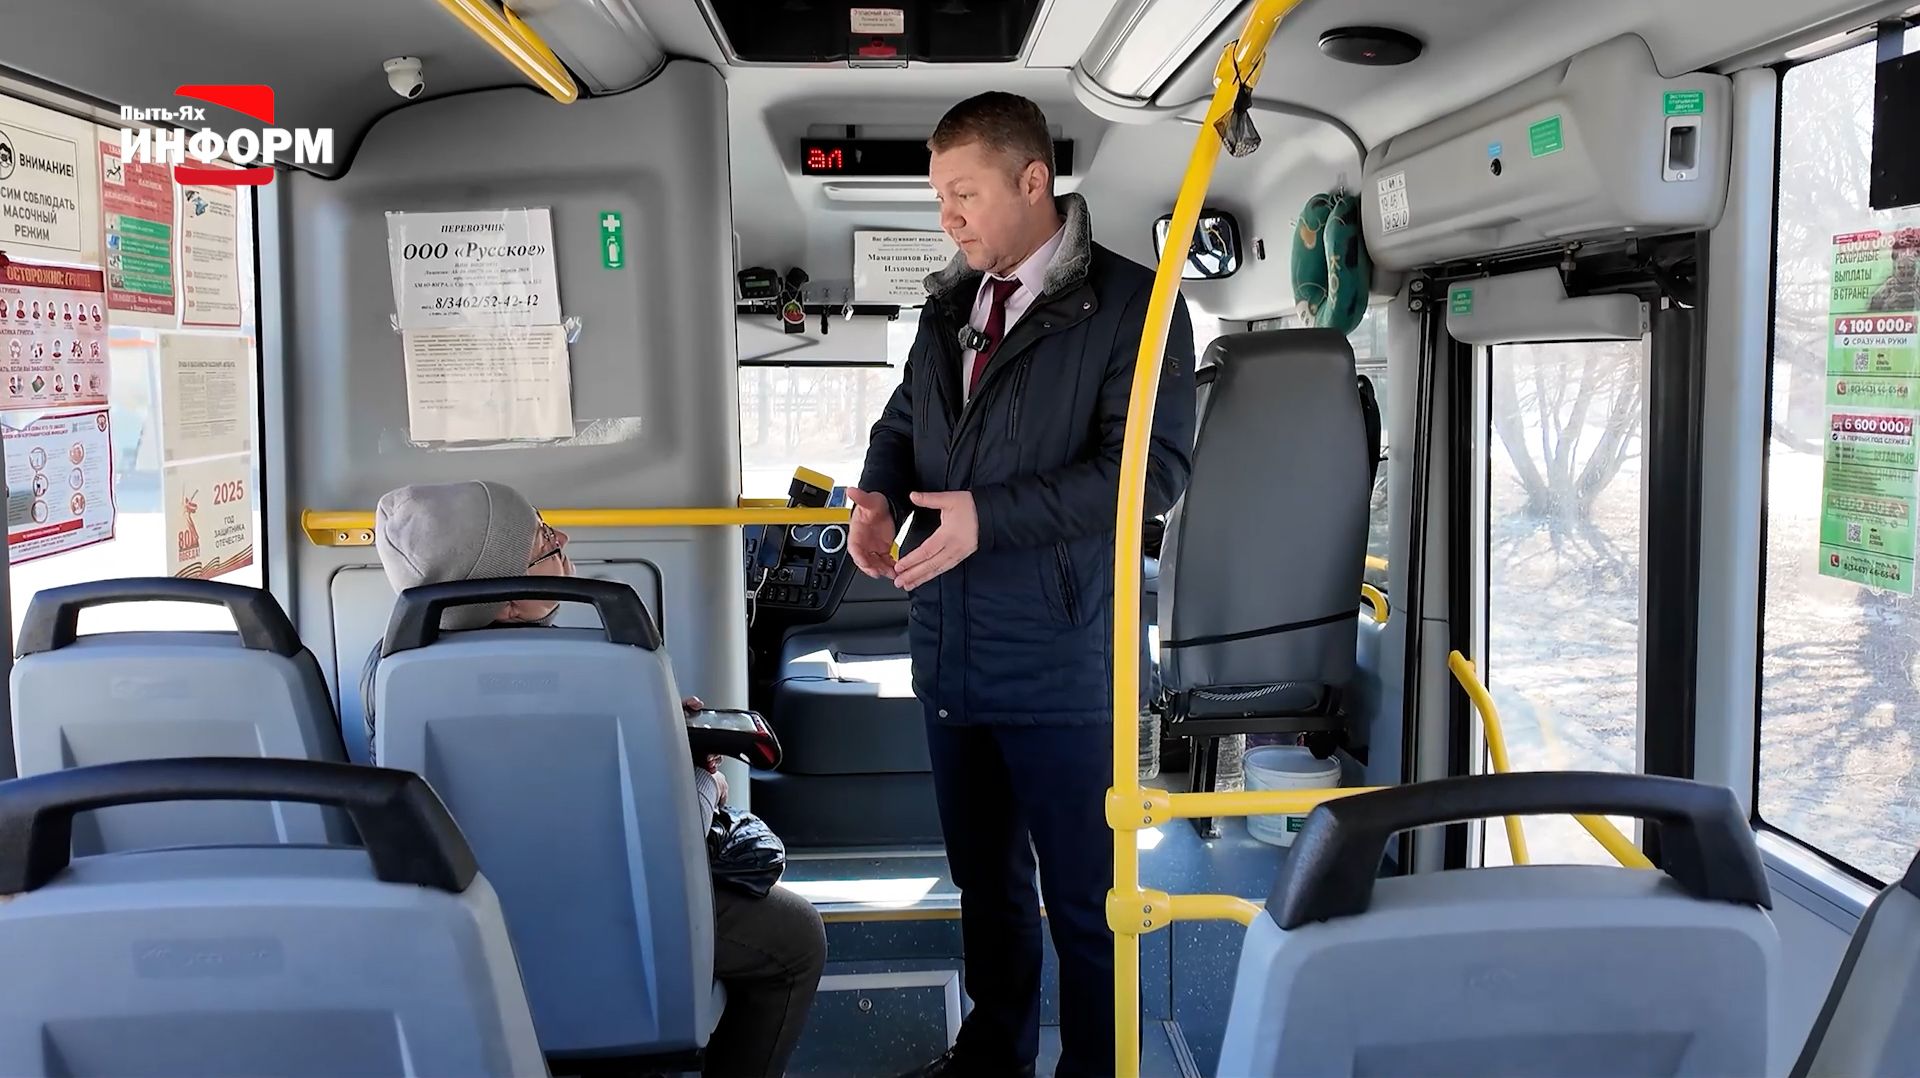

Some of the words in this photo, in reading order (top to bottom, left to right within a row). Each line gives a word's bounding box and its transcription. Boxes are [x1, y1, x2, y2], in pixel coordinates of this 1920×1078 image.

[19, 152, 75, 178] ВНИМАНИЕ!
[23, 190, 76, 211] СОБЛЮДАТЬ
[3, 203, 58, 225] МАСОЧНЫЙ
[14, 224, 50, 241] РЕЖИМ
[441, 223, 505, 233] ПЕРЕВОЗЧИК
[403, 242, 449, 260] ООО
[454, 241, 546, 262] «Русское»
[1835, 249, 1880, 264] РЕКОРДНЫЕ
[1834, 268, 1872, 283] ВЫПЛАТЫ
[1833, 289, 1839, 300] В
[1840, 287, 1869, 300] СТРАНЕ!
[435, 294, 539, 310] 8/3462/52-42-42
[1838, 320, 1848, 333] 4
[1850, 319, 1873, 333] 100
[1852, 337, 1874, 345] СРАЗУ
[1888, 337, 1908, 345] РУКИ
[1844, 419, 1852, 430] 6
[1854, 419, 1877, 432] 600
[213, 480, 244, 505] 2025
[224, 515, 235, 525] ГОД
